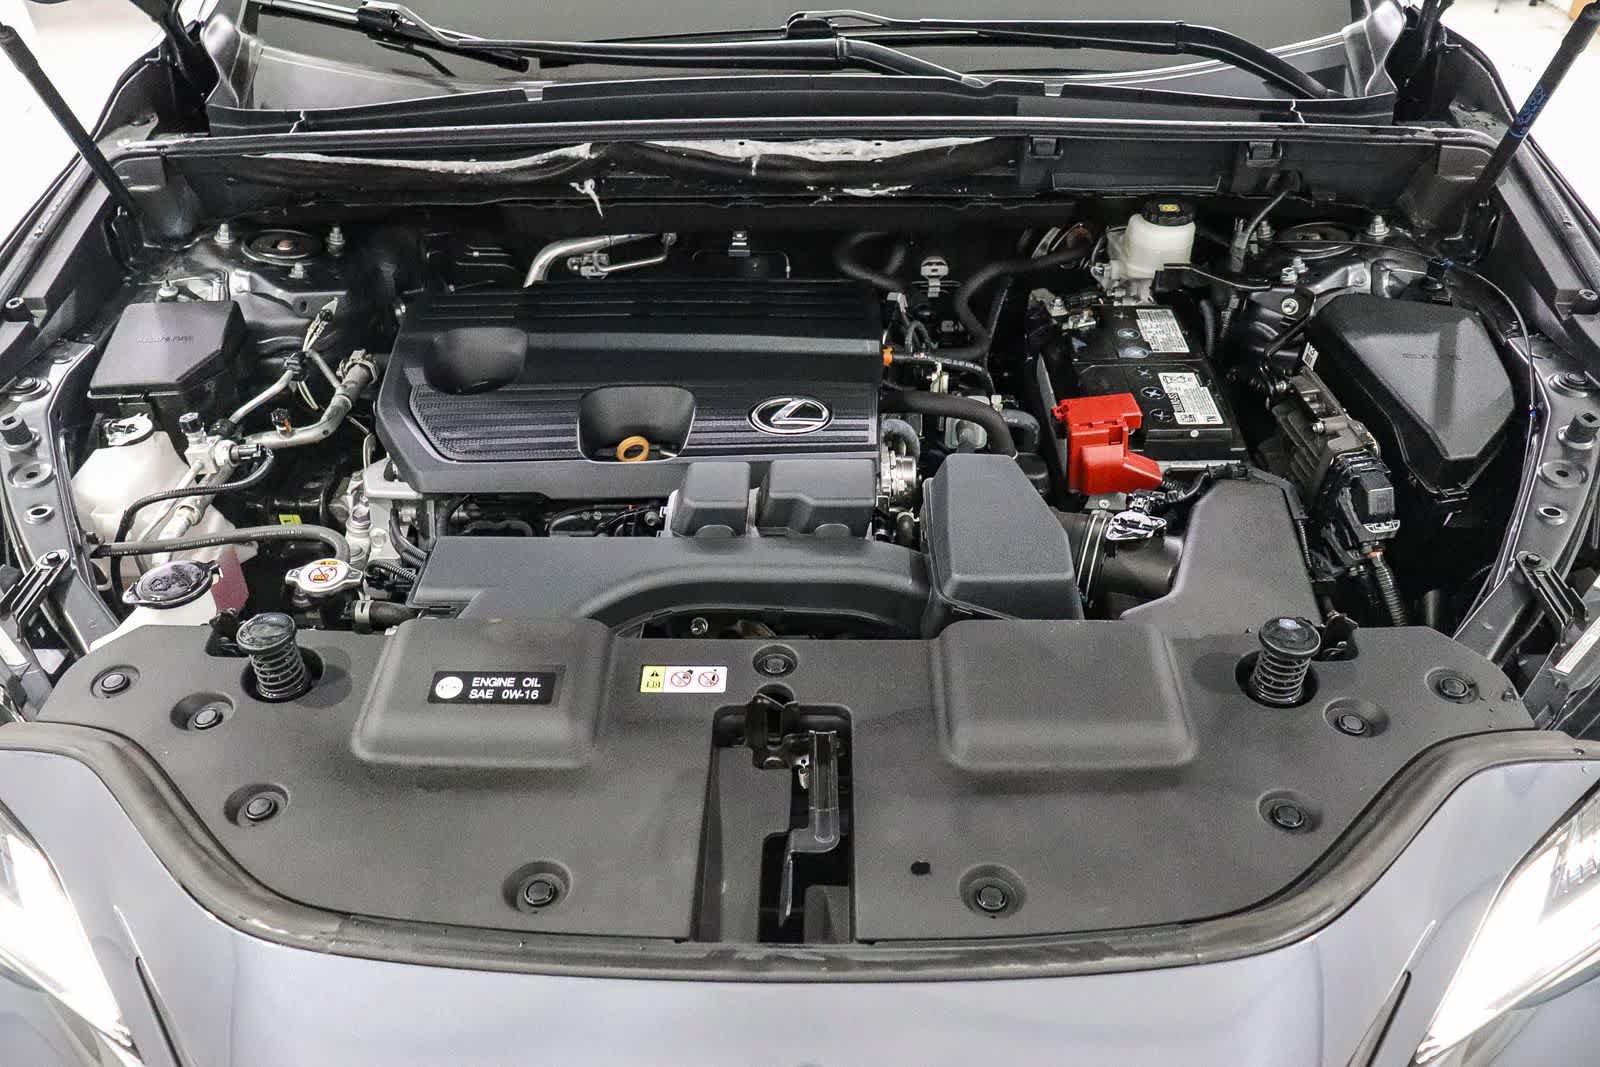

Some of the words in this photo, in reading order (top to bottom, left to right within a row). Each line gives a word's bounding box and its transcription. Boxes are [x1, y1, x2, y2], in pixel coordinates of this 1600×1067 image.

[472, 677, 515, 687] ENGINE
[522, 677, 541, 687] OIL
[469, 689, 495, 699] SAE
[501, 690, 539, 699] 0W-16
